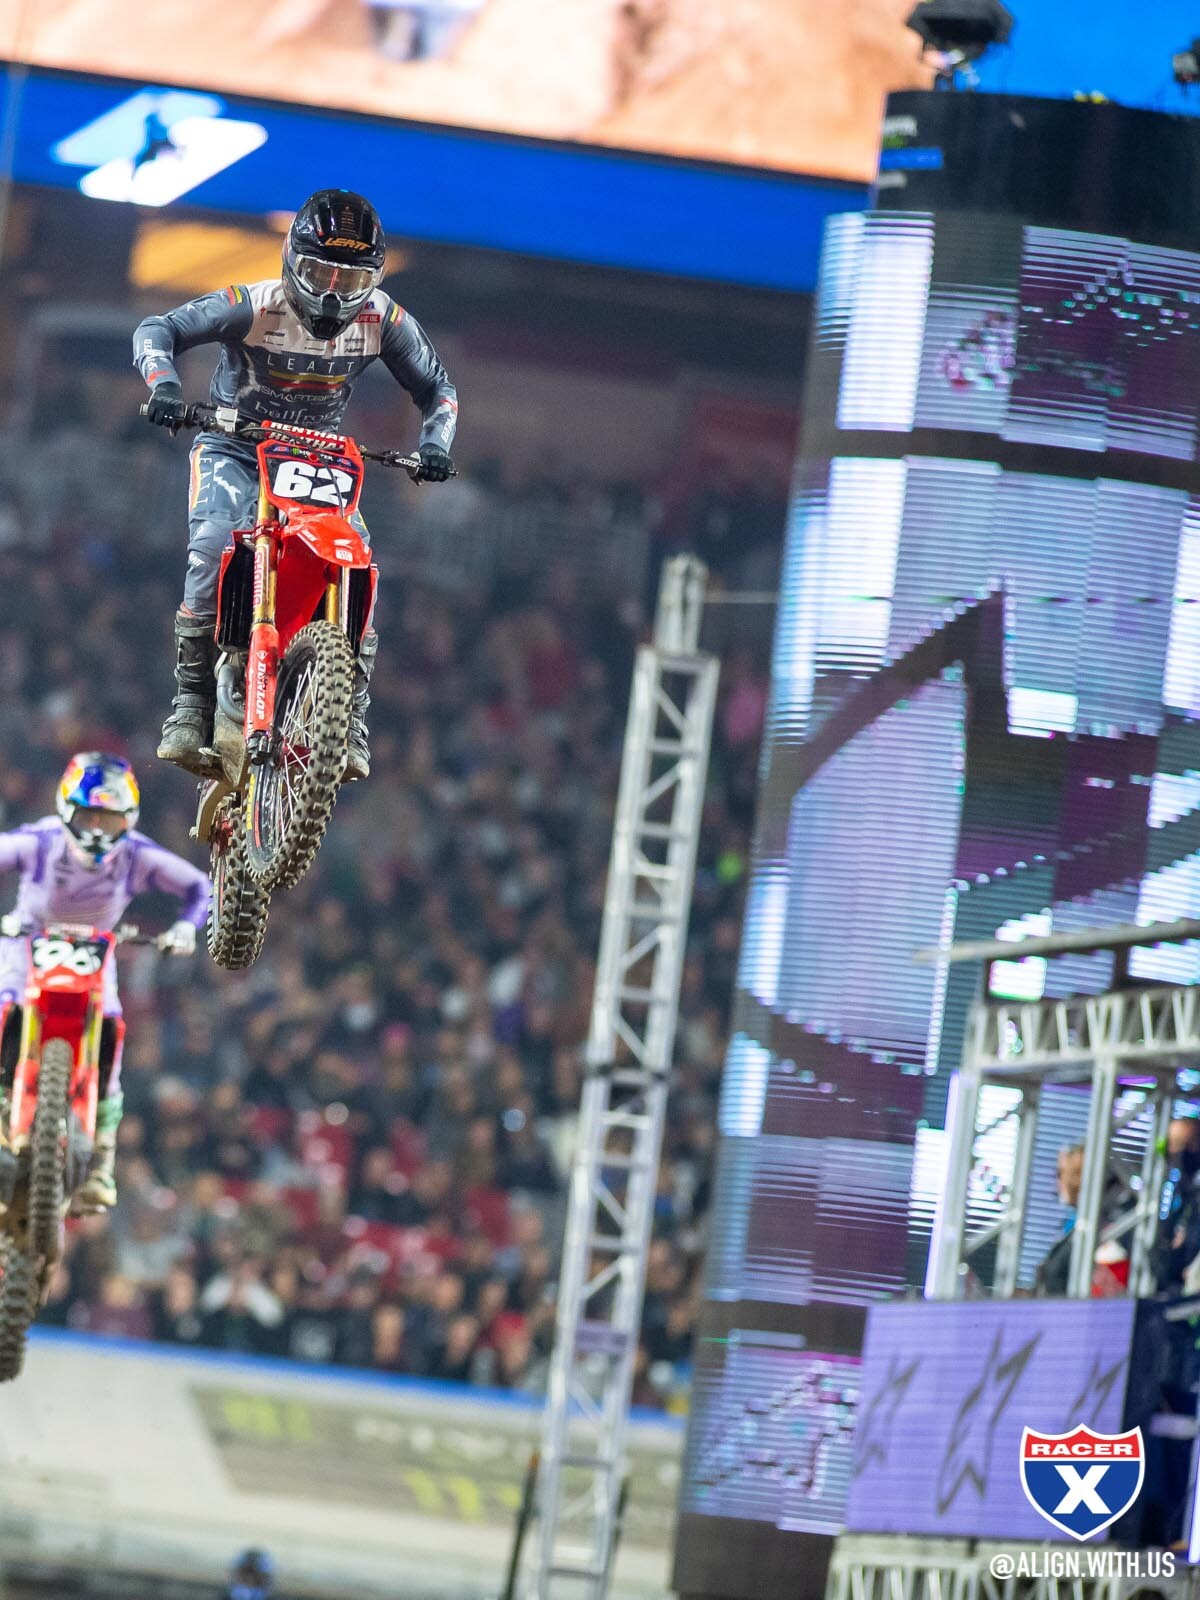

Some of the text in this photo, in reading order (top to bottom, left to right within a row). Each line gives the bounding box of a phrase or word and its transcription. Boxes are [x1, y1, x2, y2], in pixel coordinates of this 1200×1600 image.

[325, 237, 372, 251] LEATT
[267, 354, 355, 374] LEATT
[271, 422, 345, 441] RENTHAL
[273, 461, 353, 507] 62
